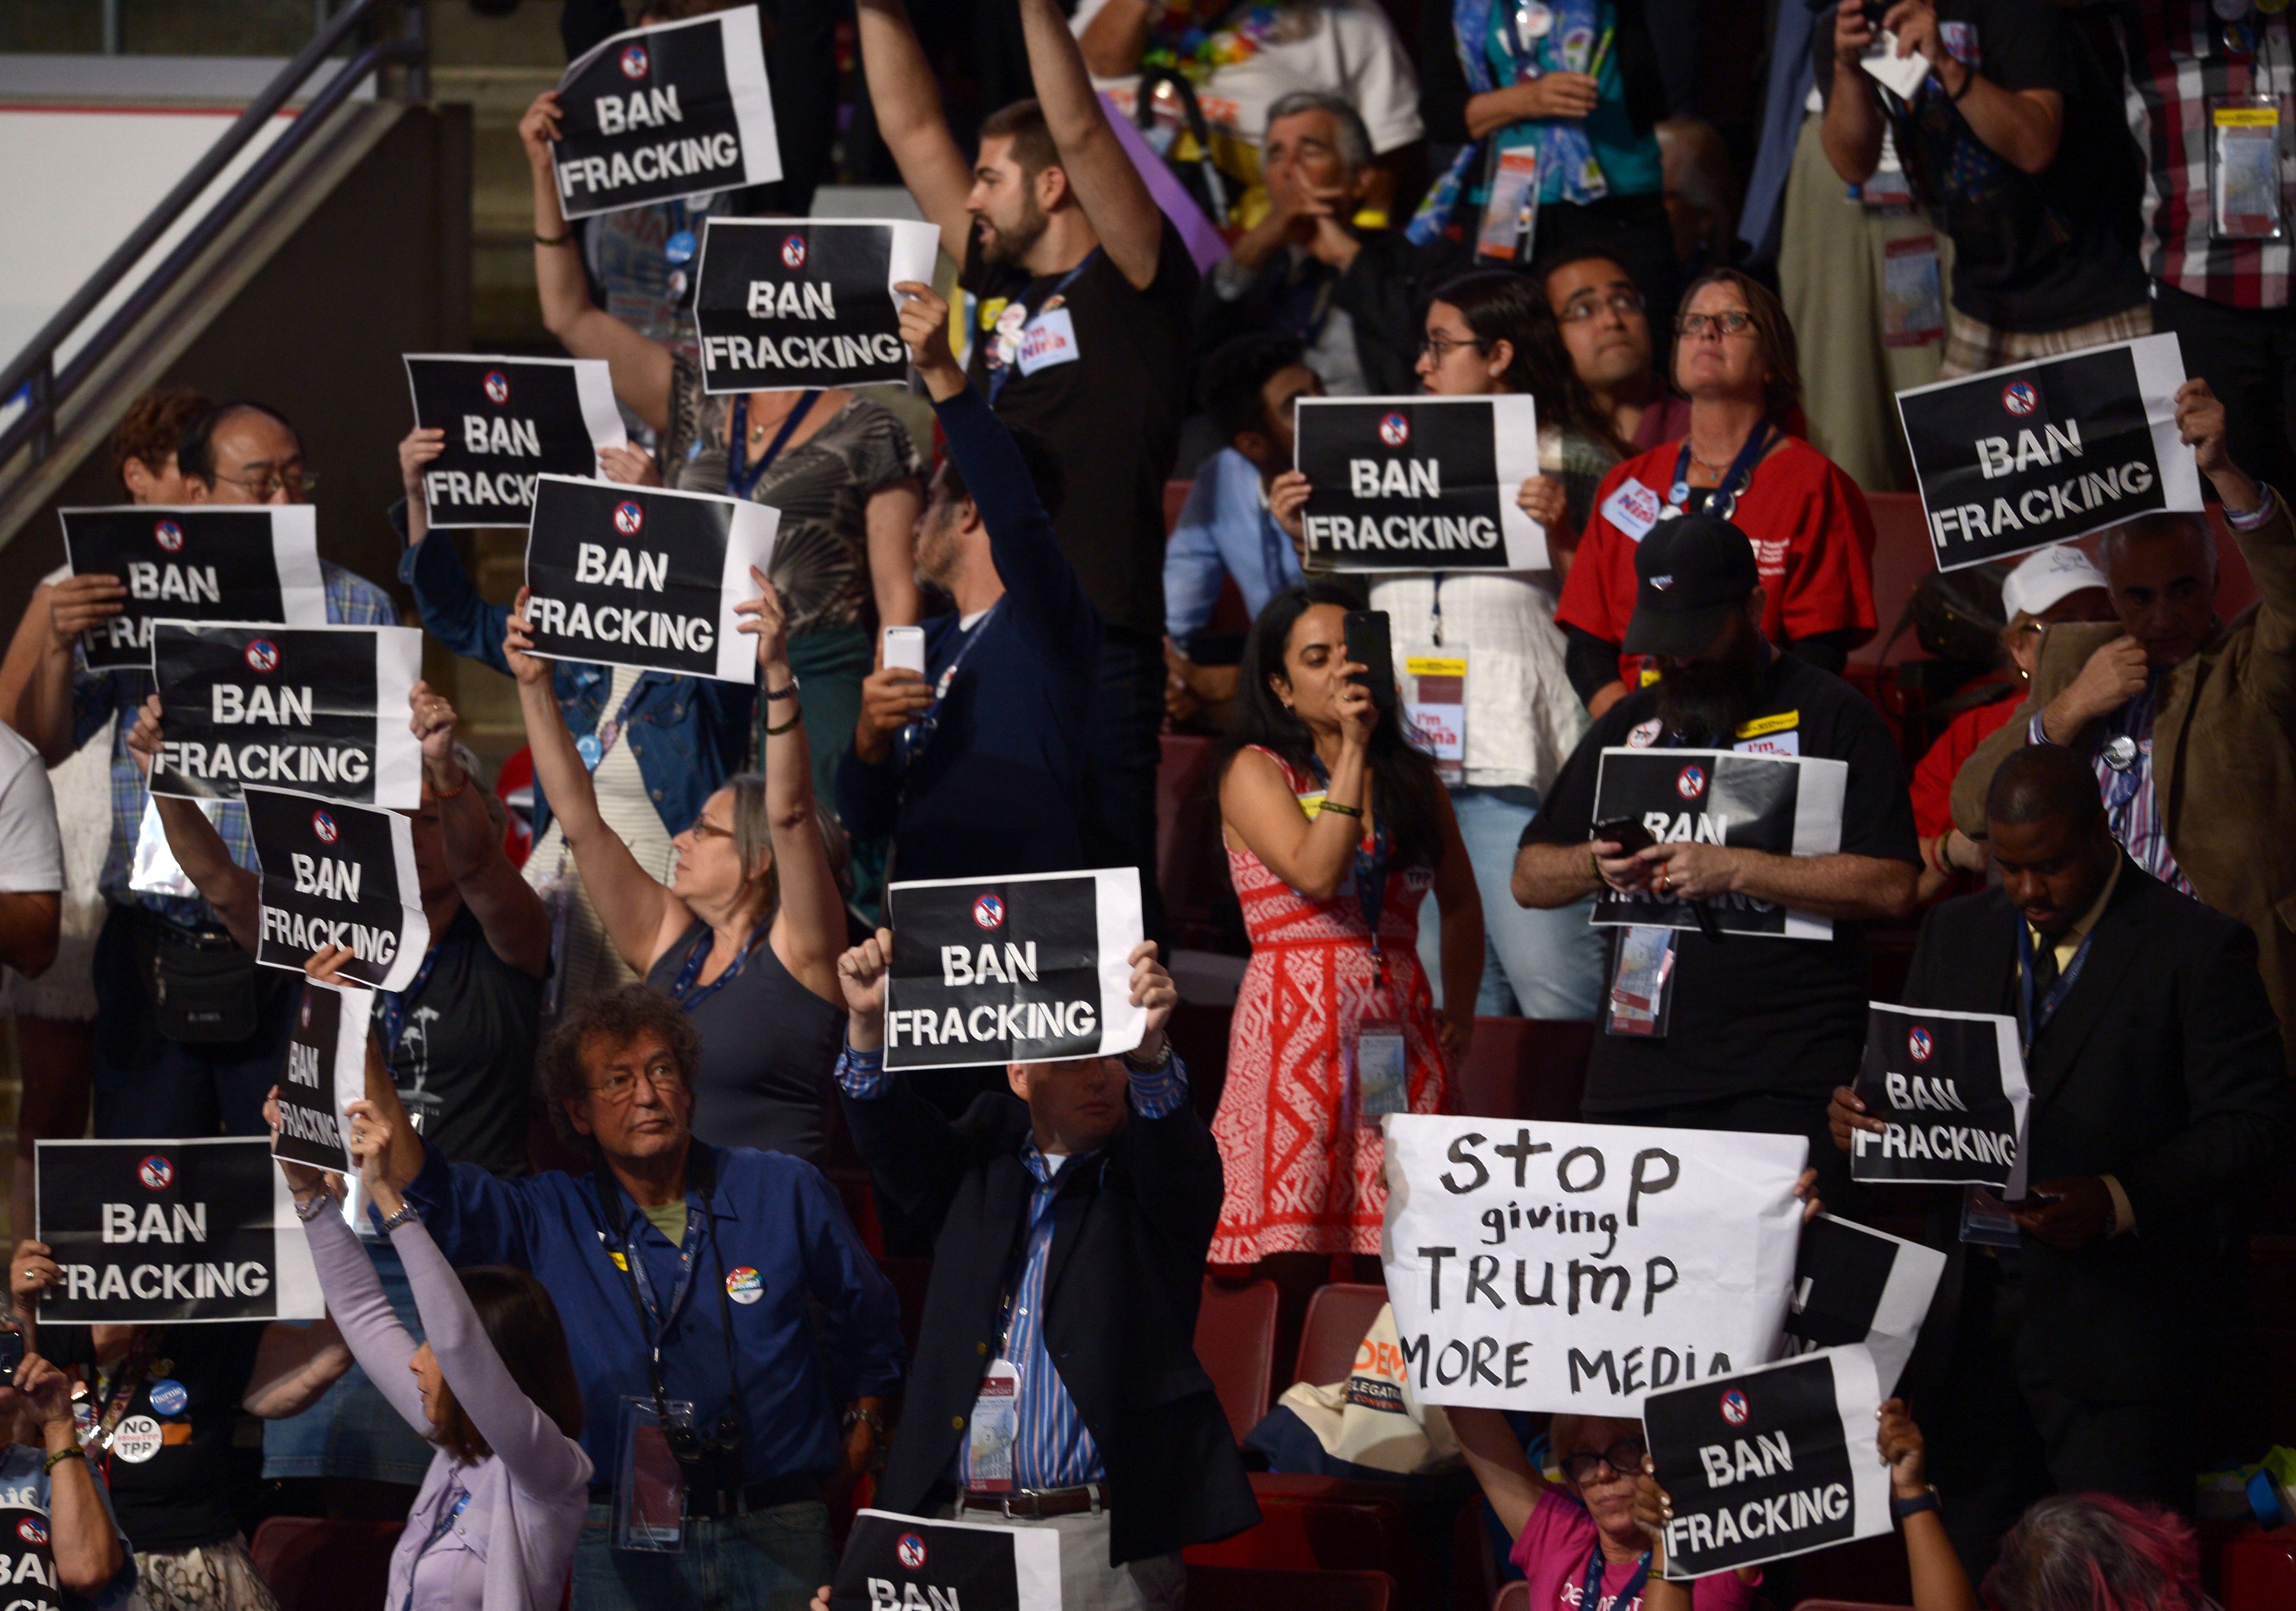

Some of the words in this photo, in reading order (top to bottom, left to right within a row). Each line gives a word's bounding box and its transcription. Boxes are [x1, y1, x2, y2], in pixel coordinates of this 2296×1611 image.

[595, 84, 683, 135] BAN
[559, 133, 739, 198] FRACKING
[747, 280, 836, 320] BAN
[704, 333, 902, 371] FRACKING
[463, 416, 541, 456] BAN
[1975, 419, 2083, 480] BAN
[426, 471, 537, 506] FRACK
[1349, 458, 1440, 499] BAN
[1930, 461, 2153, 548] FRACKING
[1306, 516, 1499, 551] FRACKING
[127, 561, 221, 605] BAN
[575, 543, 668, 592] BAN
[524, 596, 714, 653] FRACKING
[212, 684, 313, 725] BAN
[153, 741, 370, 783] FRACKING
[1643, 812, 1727, 847] BAN
[291, 852, 361, 903] BAN
[263, 905, 396, 965] FRACKING
[941, 941, 1039, 987] BAN
[888, 1000, 1096, 1048] FRACKING
[288, 1041, 320, 1089] BAN
[1886, 1071, 1968, 1112] BAN
[278, 1100, 342, 1149] FRACKING
[1855, 1125, 2016, 1167] FRACKING
[103, 1203, 206, 1244] BAN
[1480, 1201, 1620, 1259] giving
[1400, 1332, 1533, 1389] MORE
[122, 1442, 151, 1455] TPP
[124, 1421, 152, 1433] NO
[1699, 1430, 1793, 1489] BAN
[1666, 1482, 1850, 1557] FRACKING
[867, 1577, 961, 1611] BAN
